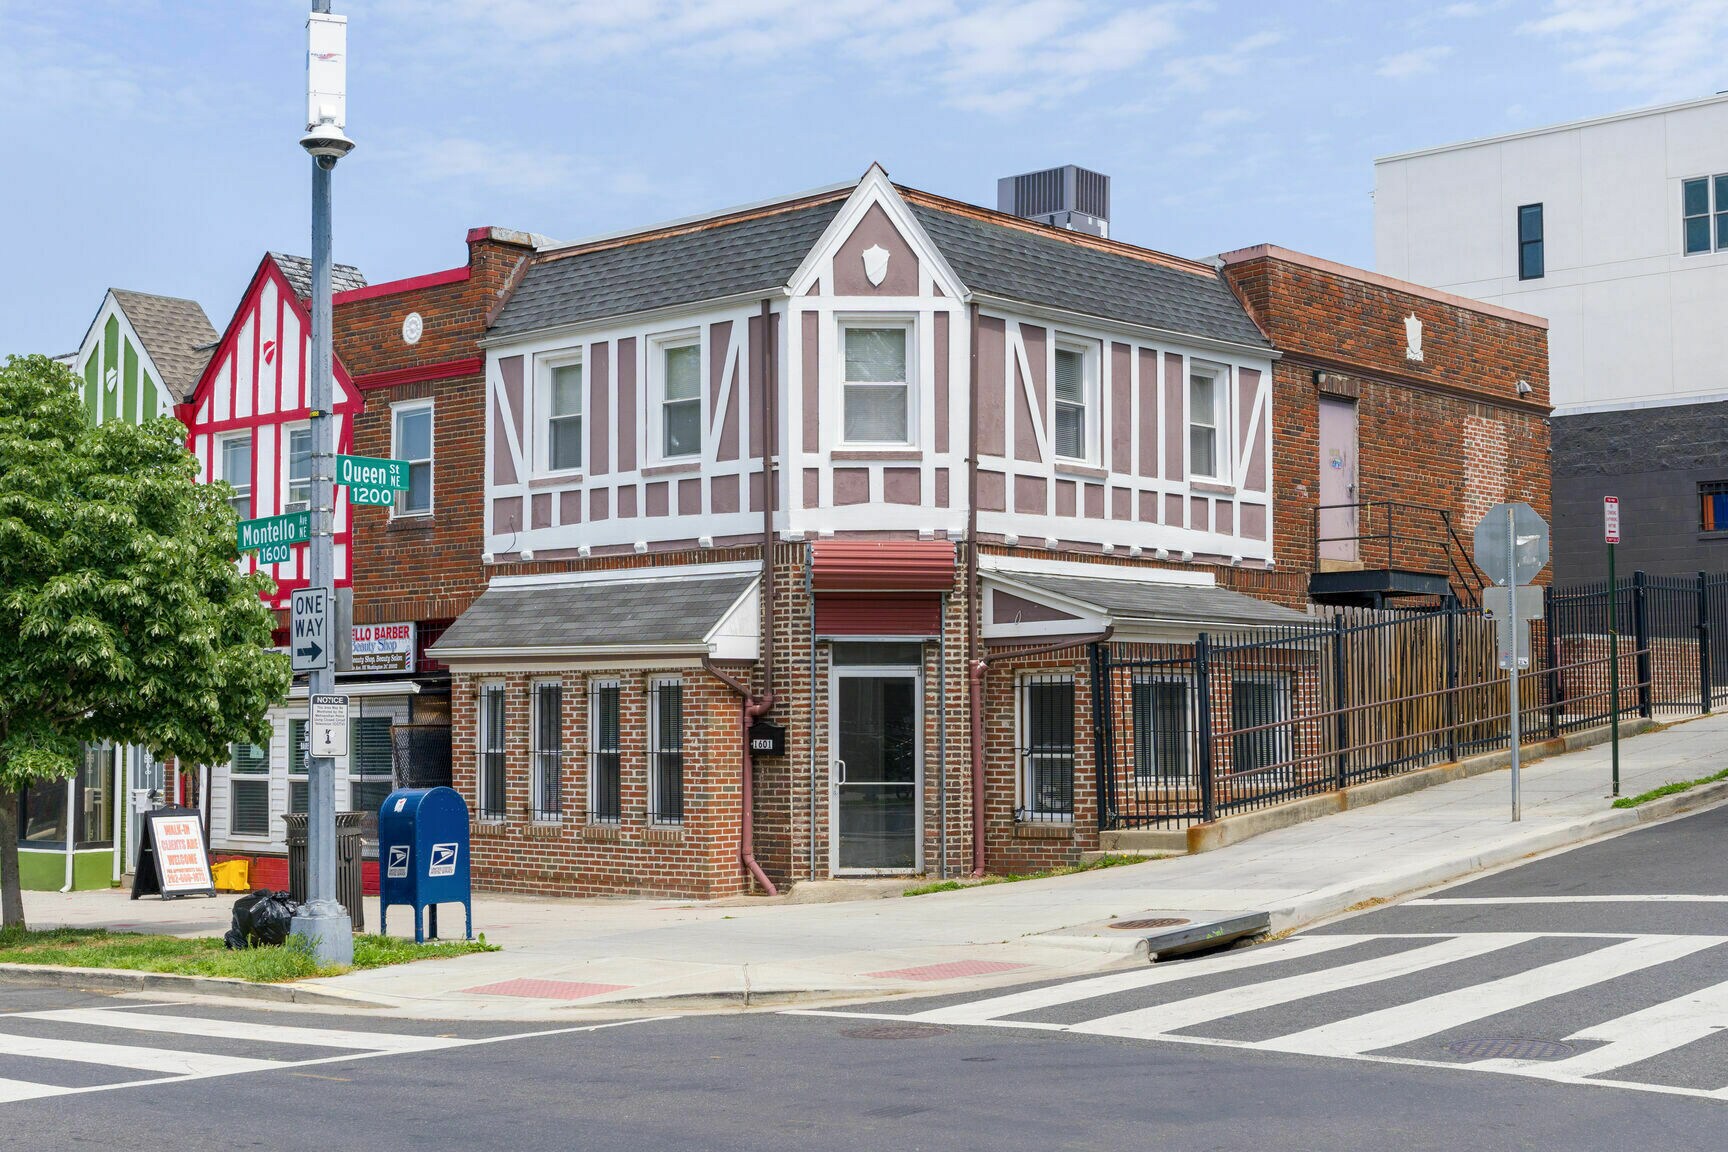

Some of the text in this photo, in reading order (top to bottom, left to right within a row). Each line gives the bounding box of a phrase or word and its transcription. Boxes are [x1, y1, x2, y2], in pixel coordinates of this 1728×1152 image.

[343, 459, 400, 485] Queen St
[390, 475, 401, 487] NE
[353, 487, 392, 504] 1200
[243, 515, 308, 547] Montello Ave
[299, 526, 307, 538] NE
[262, 546, 288, 561] 1600
[296, 594, 323, 615] ONE
[295, 617, 323, 638] WAY
[374, 625, 410, 640] BARBER
[377, 638, 397, 652] Shop
[352, 656, 365, 664] eauty
[753, 740, 772, 749] 1601
[163, 824, 191, 835] WALK-IN
[161, 838, 198, 851] CLIENTS ARE
[166, 853, 198, 866] WELCOME
